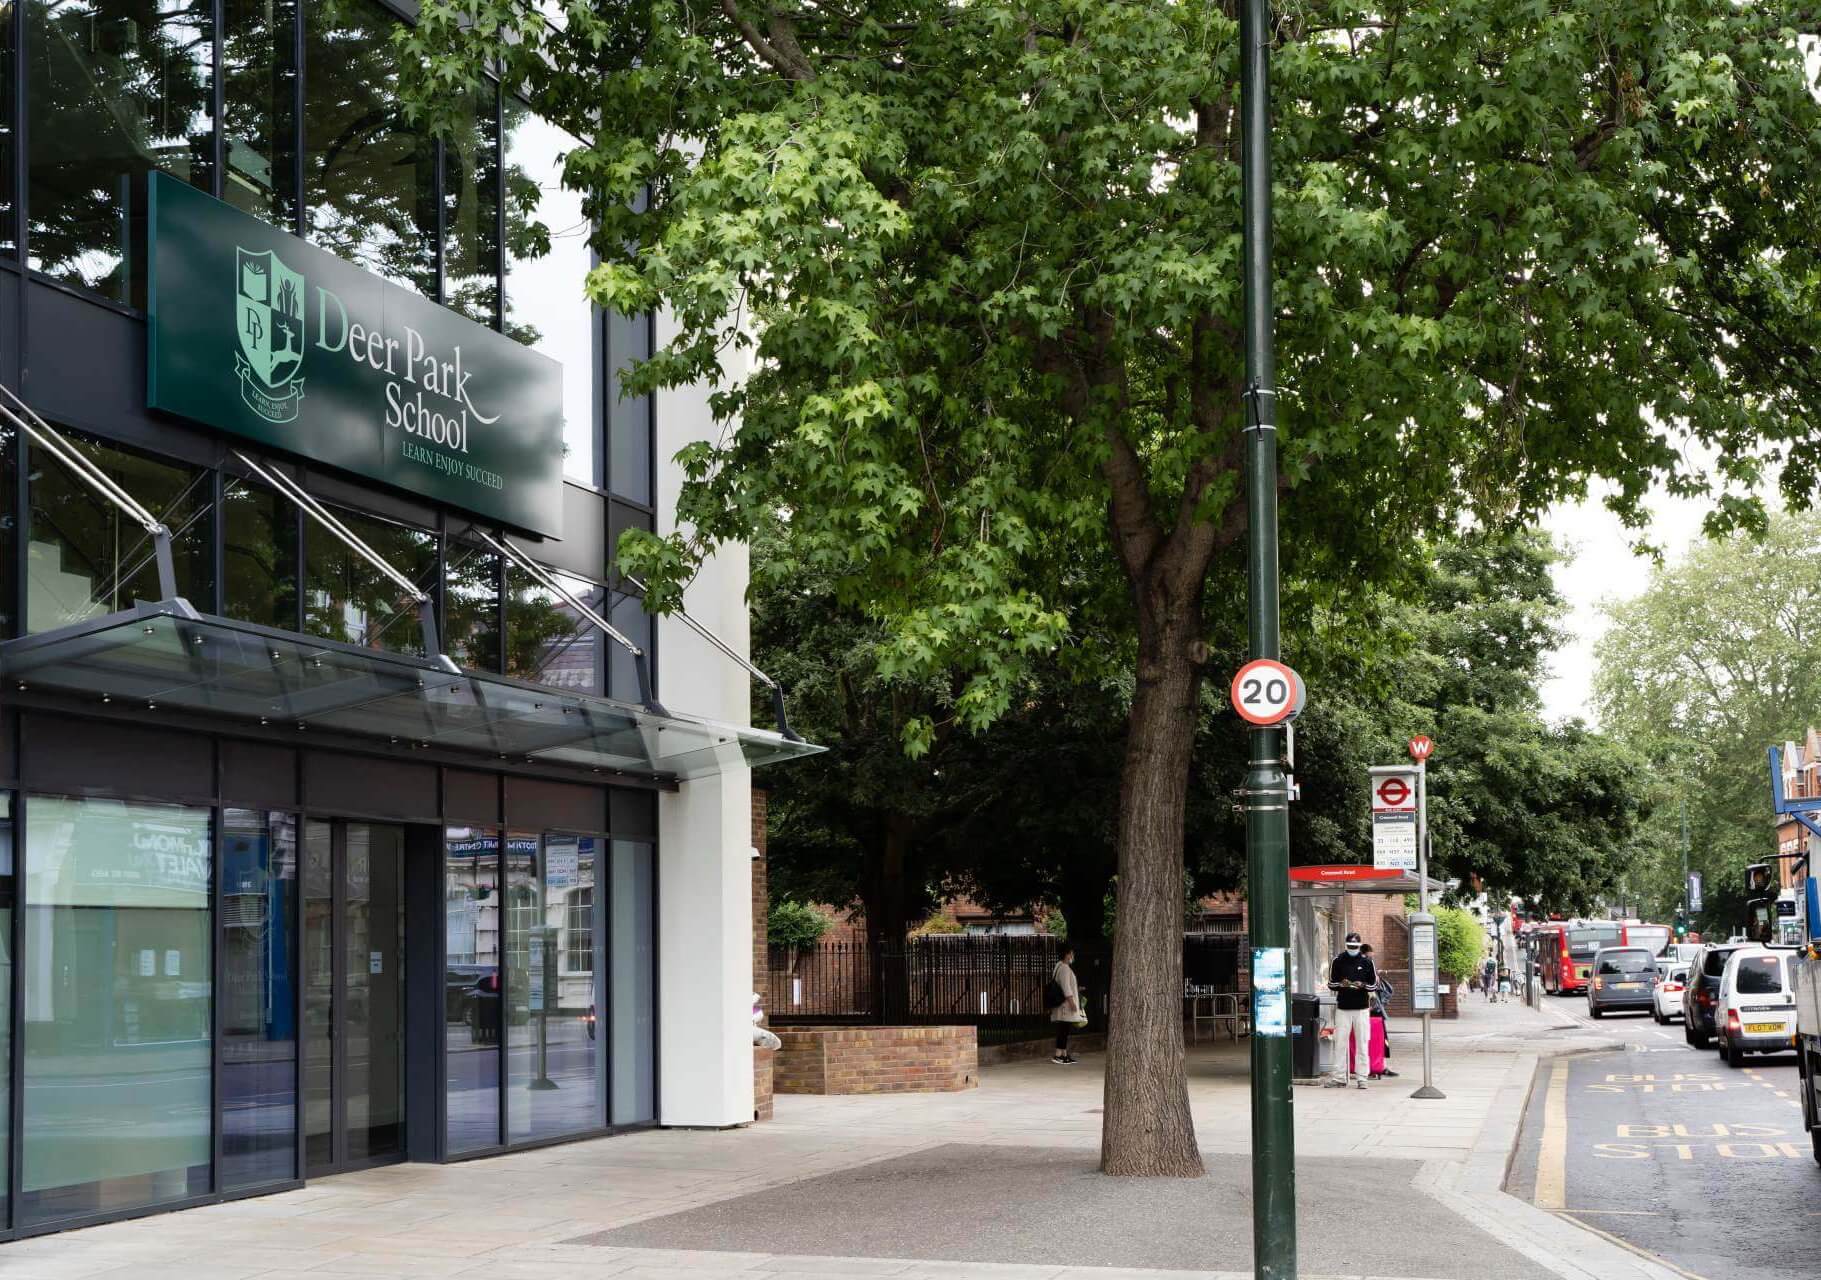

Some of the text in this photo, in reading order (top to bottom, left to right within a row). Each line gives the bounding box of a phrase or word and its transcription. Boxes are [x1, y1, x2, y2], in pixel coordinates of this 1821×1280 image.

[315, 286, 500, 424] Deer Park
[386, 381, 468, 453] School
[402, 441, 503, 490] LEARN ENJOY SUCCEED
[1243, 678, 1287, 704] 20
[1412, 741, 1430, 755] W
[1617, 1123, 1788, 1138] BUS
